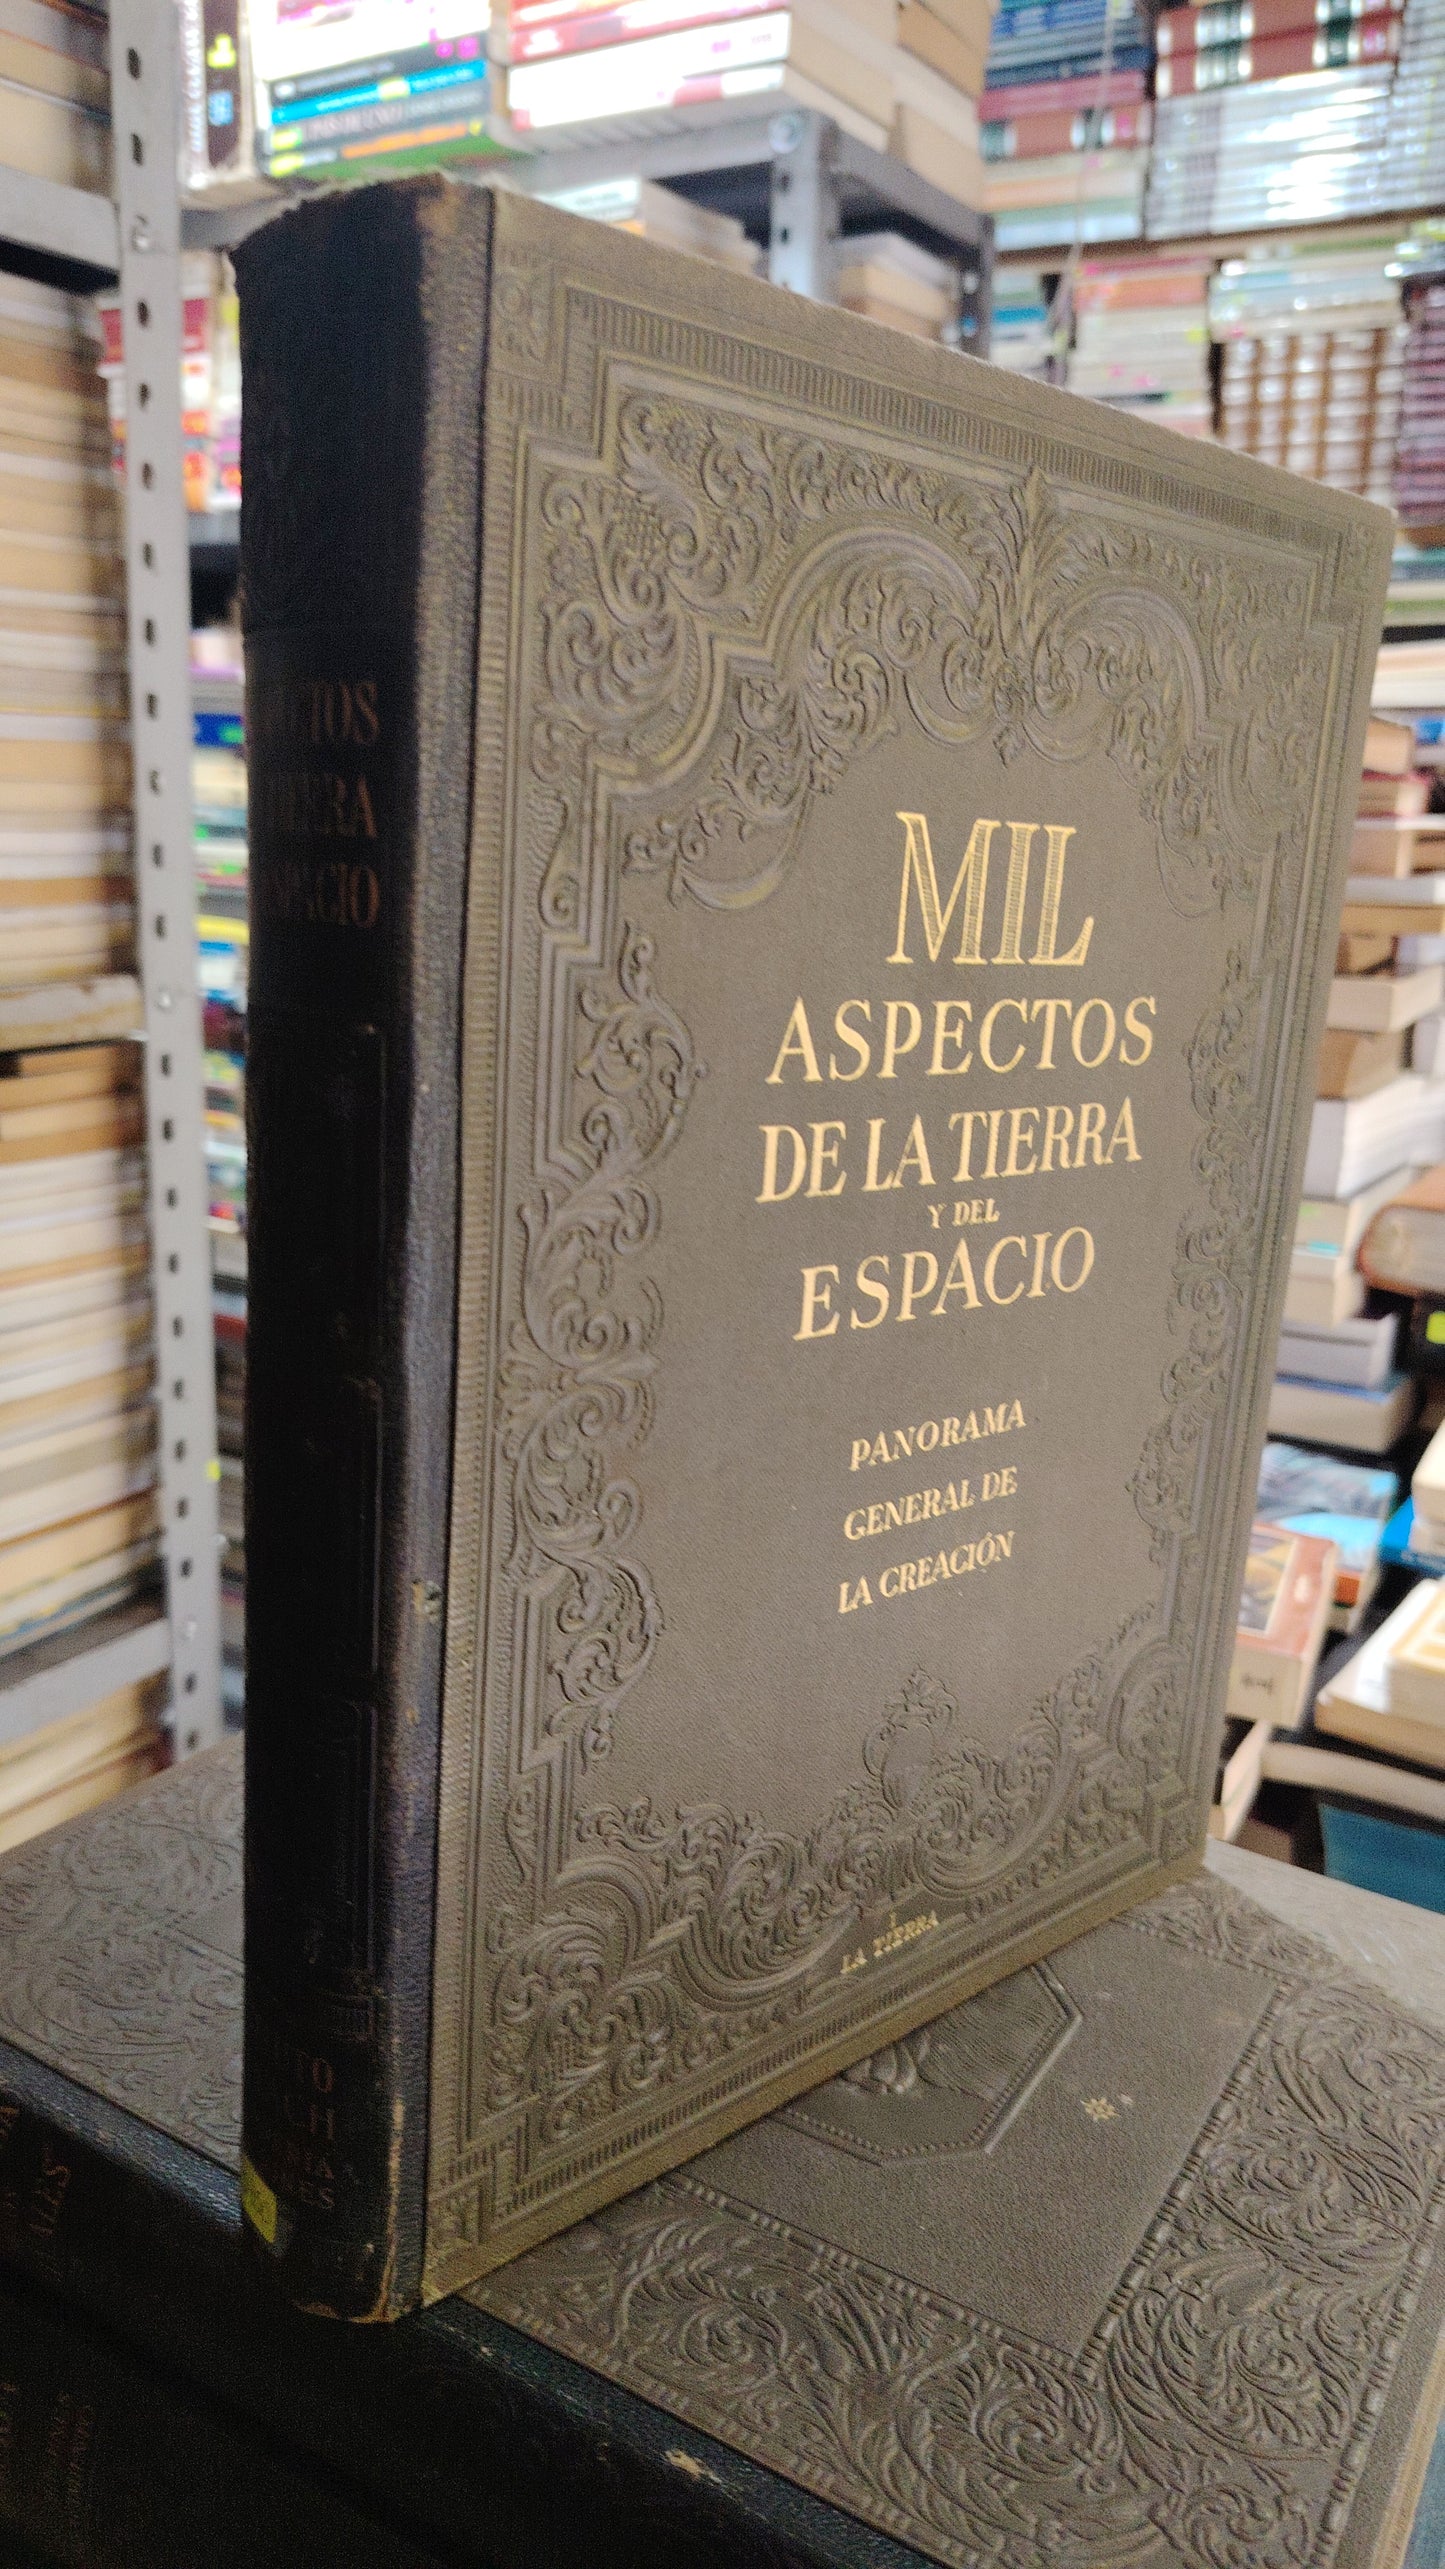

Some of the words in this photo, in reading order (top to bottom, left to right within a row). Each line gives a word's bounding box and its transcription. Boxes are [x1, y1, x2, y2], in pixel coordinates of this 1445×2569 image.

[886, 811, 1094, 966] MIL
[765, 995, 1157, 1084] ASPECTOS
[755, 1121, 847, 1203] DE
[861, 1114, 936, 1192] LA
[947, 1096, 1142, 1183] TIERRA
[928, 1203, 947, 1228] Y
[953, 1198, 1000, 1226] DEL
[792, 1226, 1095, 1341] ESPACIO
[848, 1399, 1027, 1472] PANORAMA
[843, 1479, 976, 1540] GENERAL
[981, 1465, 1018, 1502] DE
[838, 1575, 873, 1614] LA
[878, 1530, 1016, 1598] CREACIÓN
[840, 1948, 868, 1975] LA
[873, 1910, 939, 1958] TIERRA
